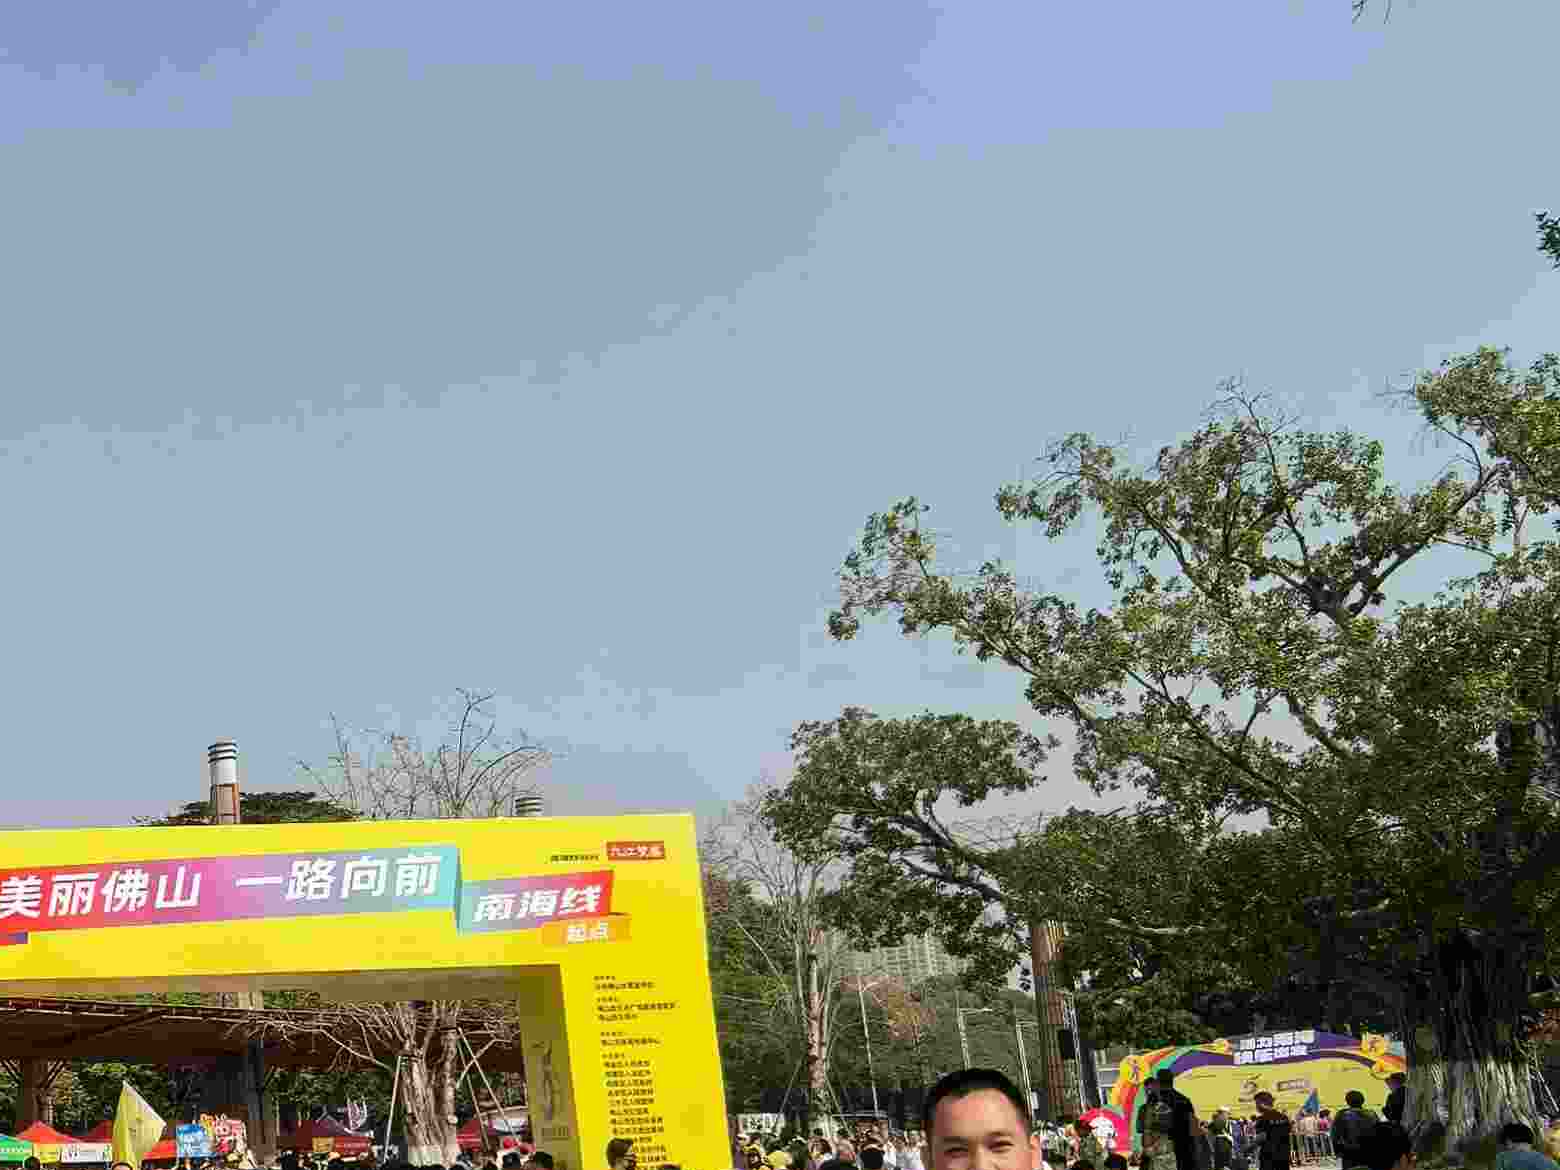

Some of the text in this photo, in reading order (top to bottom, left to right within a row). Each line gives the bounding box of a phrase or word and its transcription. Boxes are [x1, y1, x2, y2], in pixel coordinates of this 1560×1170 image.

[235, 853, 440, 901] 一路向前
[472, 885, 601, 923] 南海线
[567, 922, 609, 943] 起点
